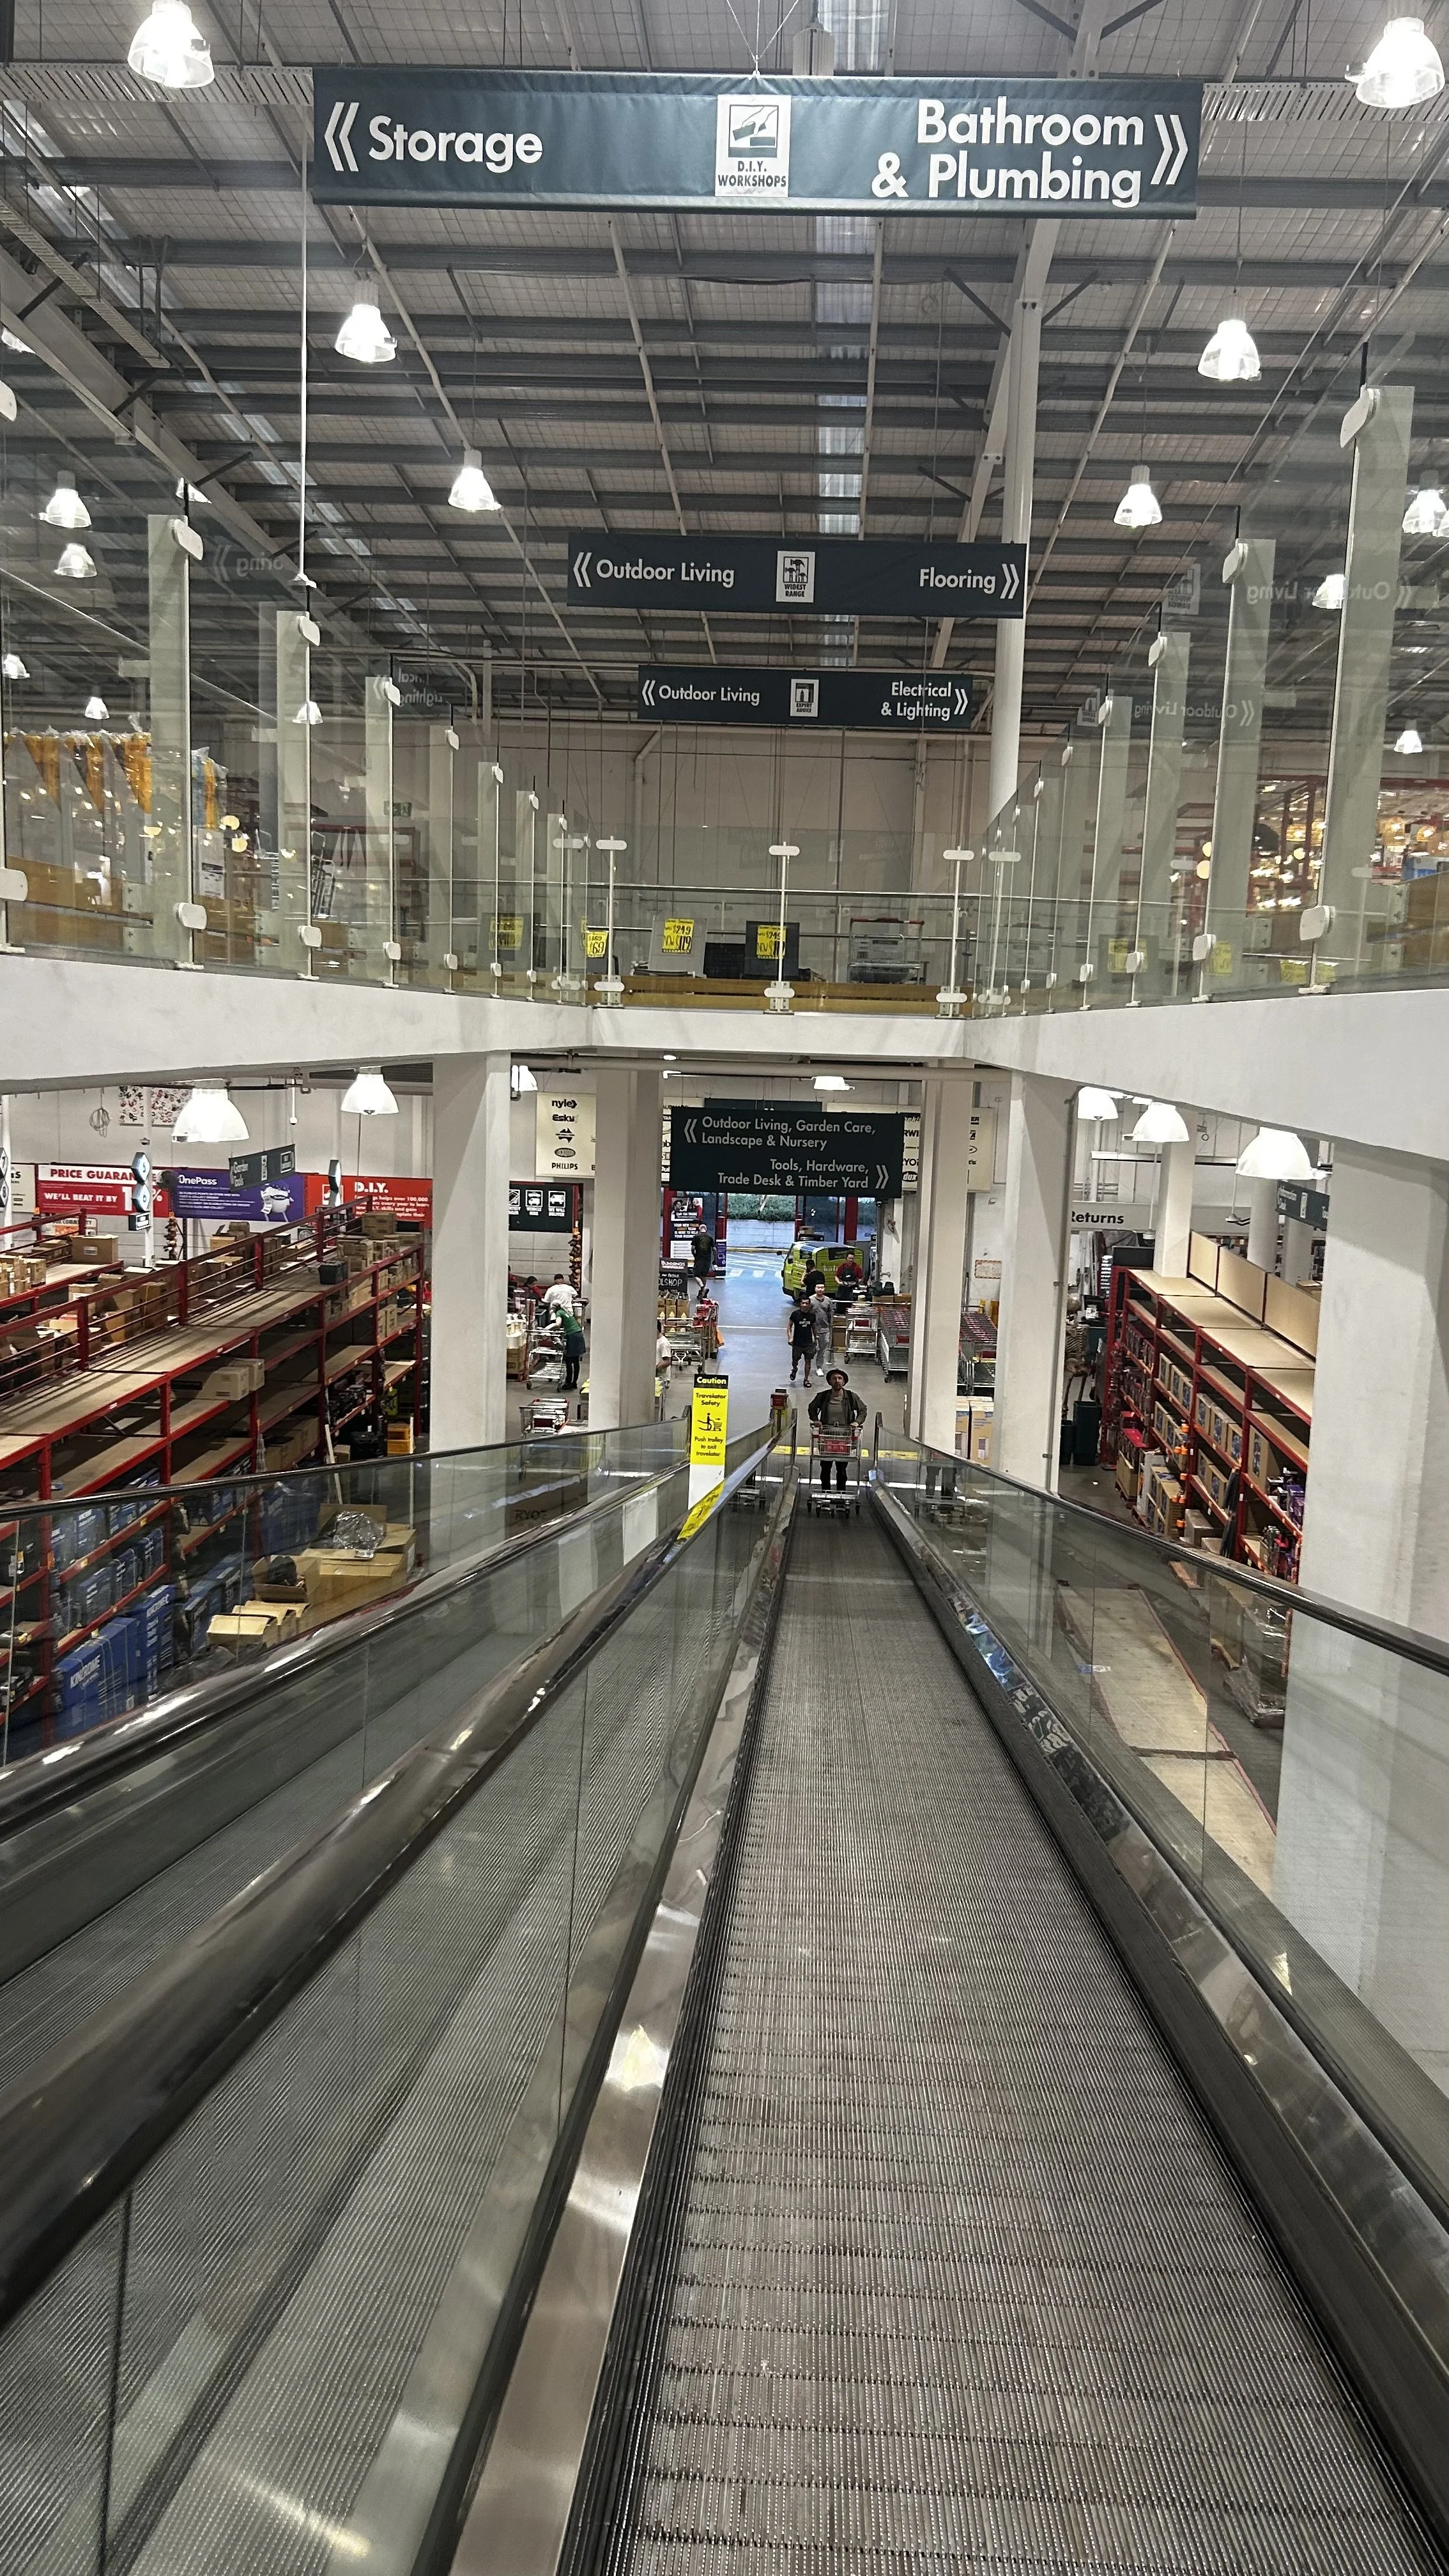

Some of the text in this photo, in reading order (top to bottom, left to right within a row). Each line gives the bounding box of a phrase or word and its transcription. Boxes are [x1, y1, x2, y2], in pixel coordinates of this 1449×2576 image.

[917, 96, 1144, 146] Bathroom
[369, 115, 543, 173] Storage
[737, 160, 767, 172] D.I.Y.
[717, 174, 786, 187] WORKSHOPS
[871, 150, 1141, 208] & Plumbing
[596, 558, 735, 588] Outdoor Living
[920, 567, 996, 594] Flooring
[784, 583, 807, 591] WIDEST
[659, 685, 760, 706] Outdoor Living
[891, 680, 951, 697] Electrical
[881, 701, 951, 721] & Lighting
[703, 1116, 875, 1135] Outdoor Living, Garden Care,
[702, 1132, 827, 1151] Landscape & Nursery
[2, 1156, 6, 1169] 7
[142, 1163, 146, 1173] 5
[551, 1162, 578, 1171] PHILIPS
[770, 1158, 869, 1174] Tools, Hardware,
[50, 1169, 157, 1181] PRICE GUARANE
[178, 1174, 218, 1186] OnePass
[717, 1172, 869, 1188] Trade Desk & Timber Yard
[355, 1182, 389, 1193] D.I.Y.
[44, 1192, 70, 1201] WE'LL
[73, 1194, 94, 1202] BEAT
[122, 1186, 163, 1211] 1%
[696, 1376, 727, 1385] Caution
